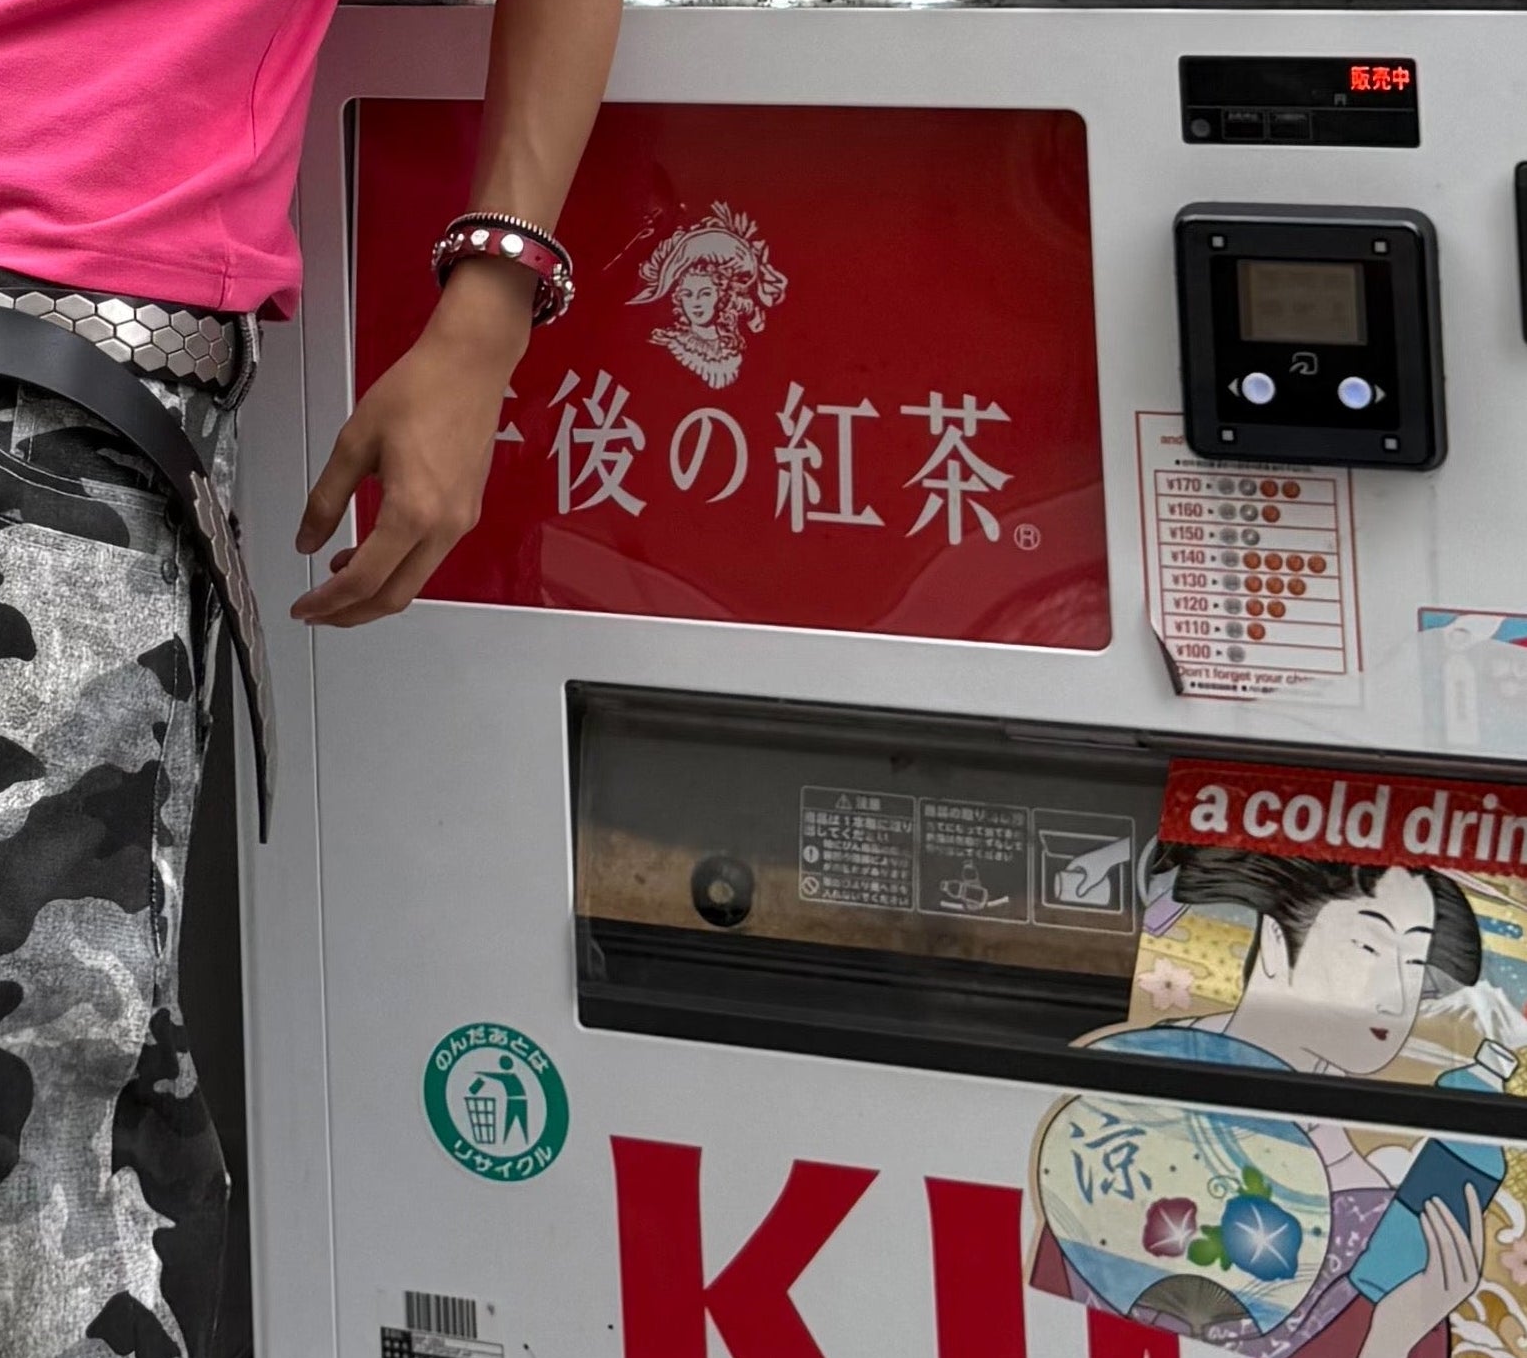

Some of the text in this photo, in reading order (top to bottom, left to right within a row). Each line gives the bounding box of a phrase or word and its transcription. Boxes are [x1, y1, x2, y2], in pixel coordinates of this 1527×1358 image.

[1349, 66, 1410, 92] 販売中
[1167, 478, 1202, 493] ¥170
[1170, 526, 1204, 541] ¥150
[1171, 550, 1205, 564] ¥140
[1173, 573, 1207, 588] ¥130
[1174, 596, 1208, 611] ¥120
[1175, 620, 1210, 635] ¥110
[1177, 644, 1211, 658] ¥100
[1213, 667, 1251, 684] forget
[1255, 672, 1283, 685] your
[1190, 787, 1230, 834] a
[1242, 780, 1391, 853] cold
[434, 1023, 551, 1073] のんだあとは
[452, 1138, 555, 1177] リサイクル
[1068, 1116, 1152, 1206] 涼
